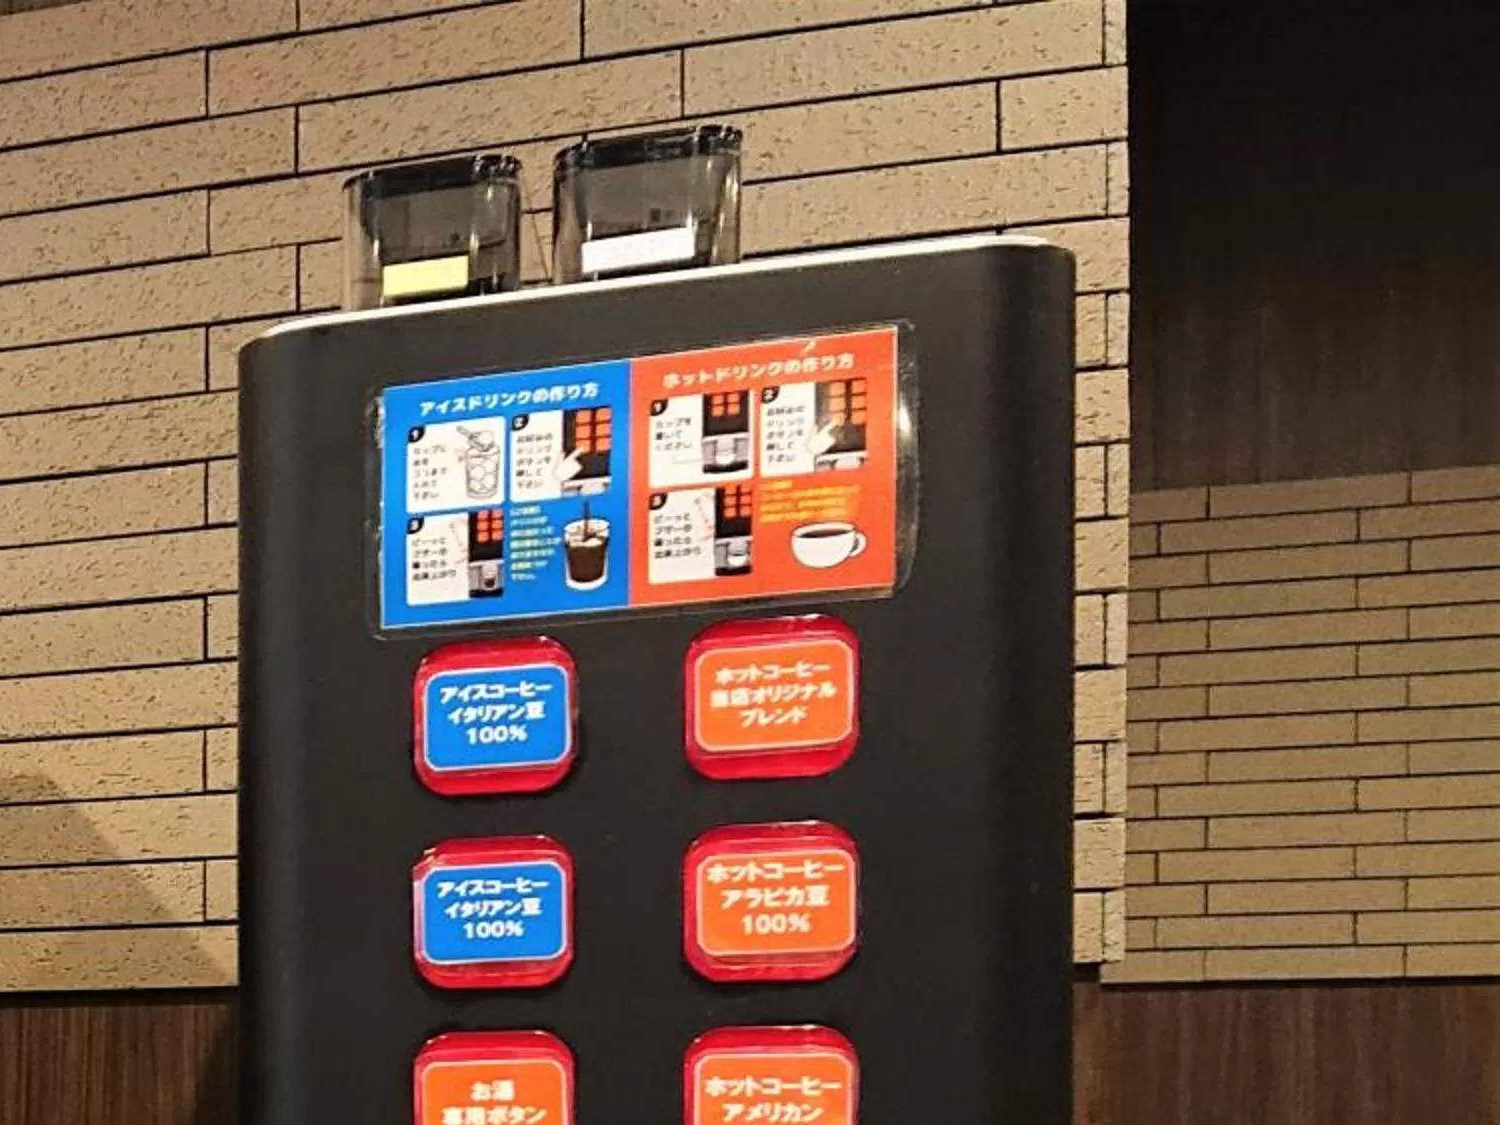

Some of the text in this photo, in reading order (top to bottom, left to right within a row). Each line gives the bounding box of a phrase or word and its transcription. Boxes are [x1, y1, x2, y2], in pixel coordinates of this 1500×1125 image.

[663, 353, 855, 389] ホットドリンクの作り方
[420, 382, 599, 416] アイスドリンクの作り方
[715, 661, 832, 685] ホットコーヒー
[440, 680, 552, 702] アイスコーヒー
[448, 701, 546, 724] イタリアン豆
[739, 705, 809, 728] ブレンド
[467, 726, 528, 745] 100%
[707, 860, 845, 885] ホットコーヒー
[436, 877, 549, 899] アイスコーヒー
[720, 885, 831, 910] アラビカ豆
[444, 896, 542, 920] イタリアン豆
[463, 921, 524, 940] 100%
[741, 914, 812, 936] 100%
[705, 1075, 842, 1099] ホットコーヒー
[722, 1102, 825, 1125] アメリカン
